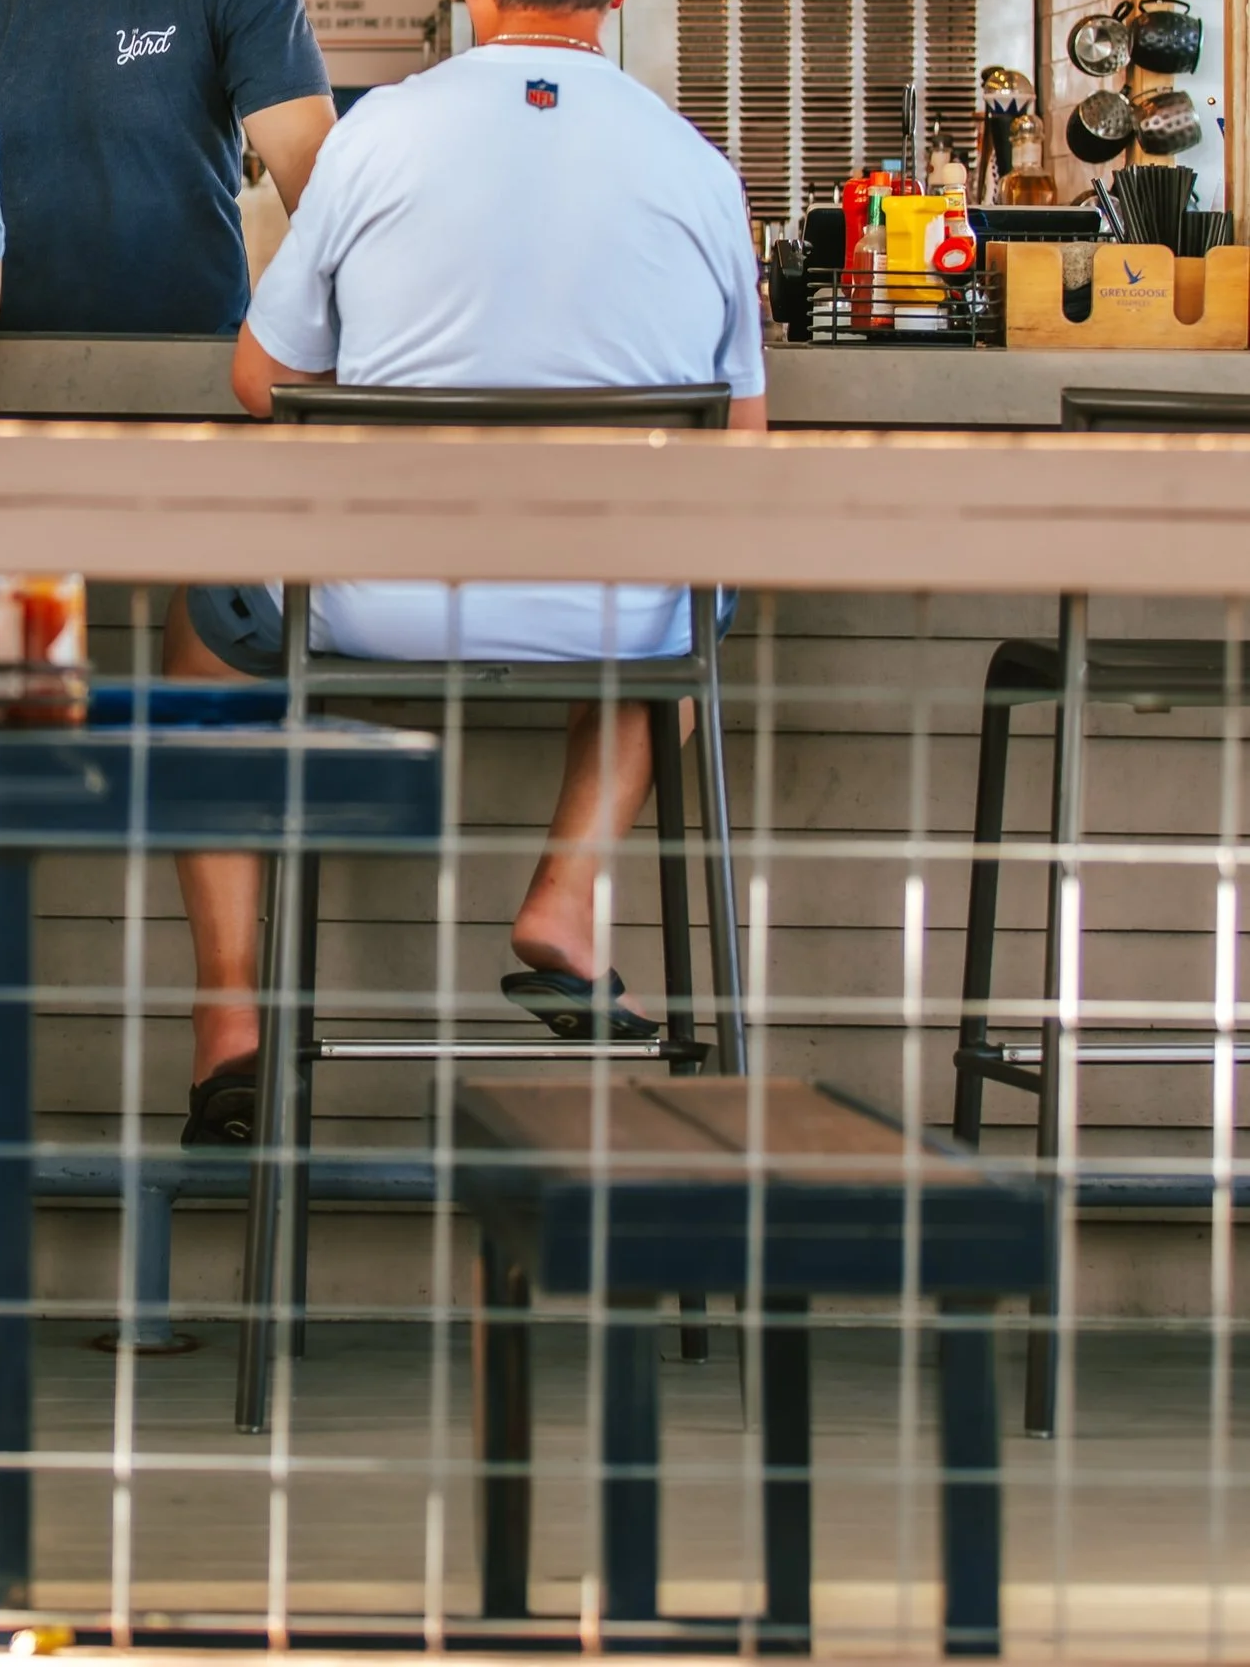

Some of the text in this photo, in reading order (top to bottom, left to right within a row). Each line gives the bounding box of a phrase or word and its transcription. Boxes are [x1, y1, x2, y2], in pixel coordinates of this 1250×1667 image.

[116, 25, 176, 65] Yard
[529, 90, 555, 107] NFL
[1100, 288, 1168, 298] GREY GOOSE
